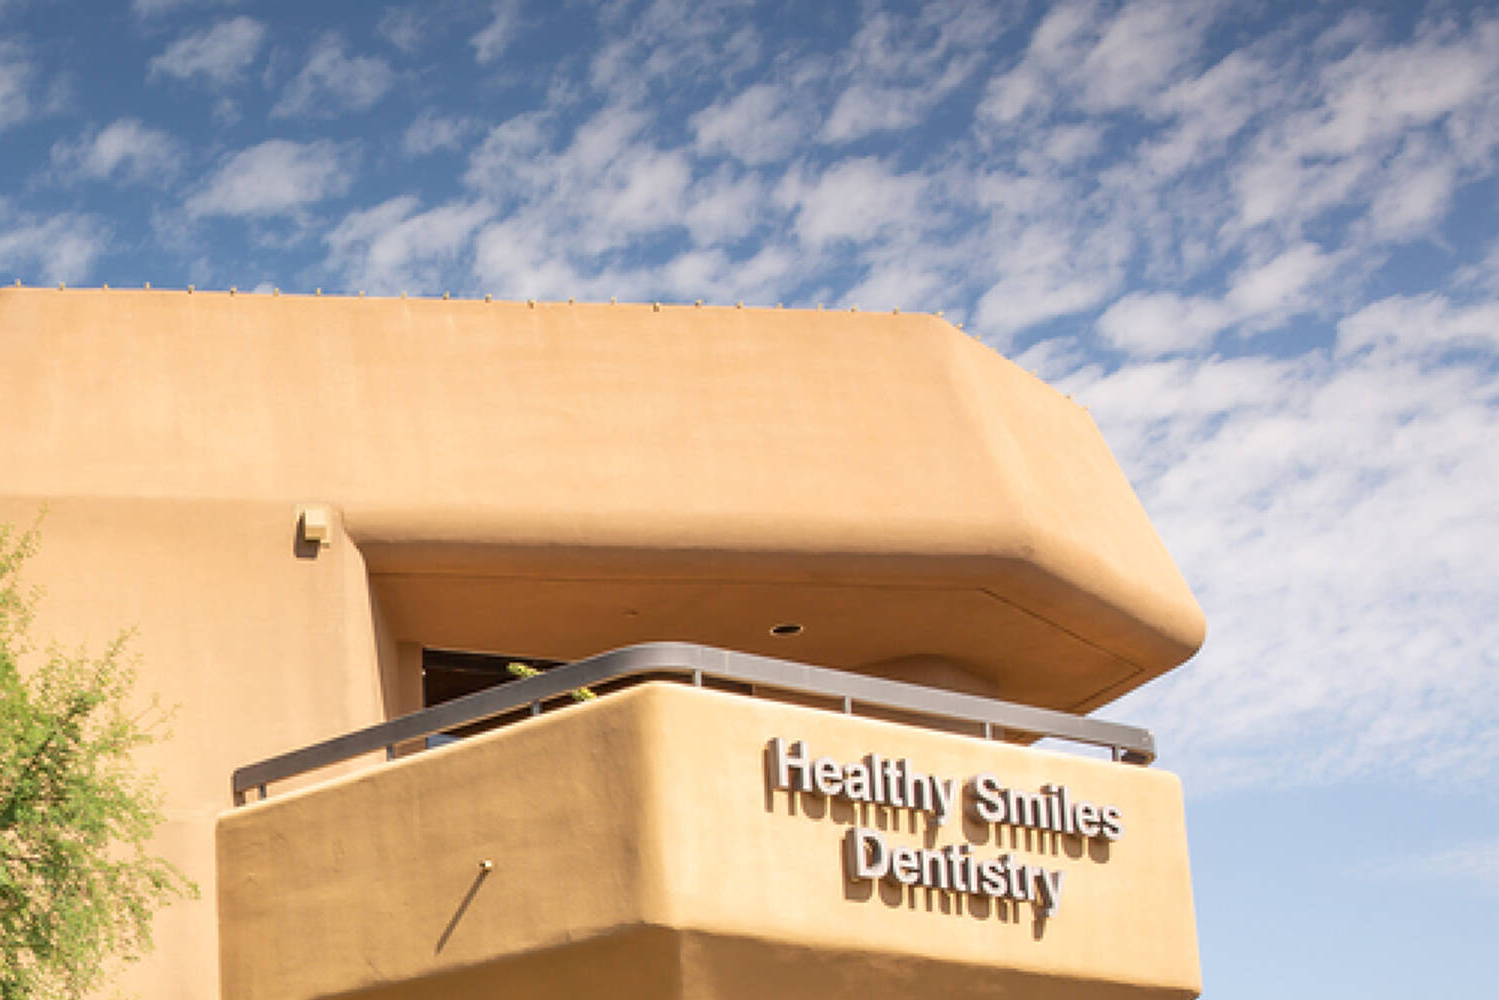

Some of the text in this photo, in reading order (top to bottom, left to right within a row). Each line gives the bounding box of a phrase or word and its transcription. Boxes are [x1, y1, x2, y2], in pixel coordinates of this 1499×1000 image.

[769, 736, 1126, 842] Healthy Smiles
[847, 827, 1066, 919] Dentistry
